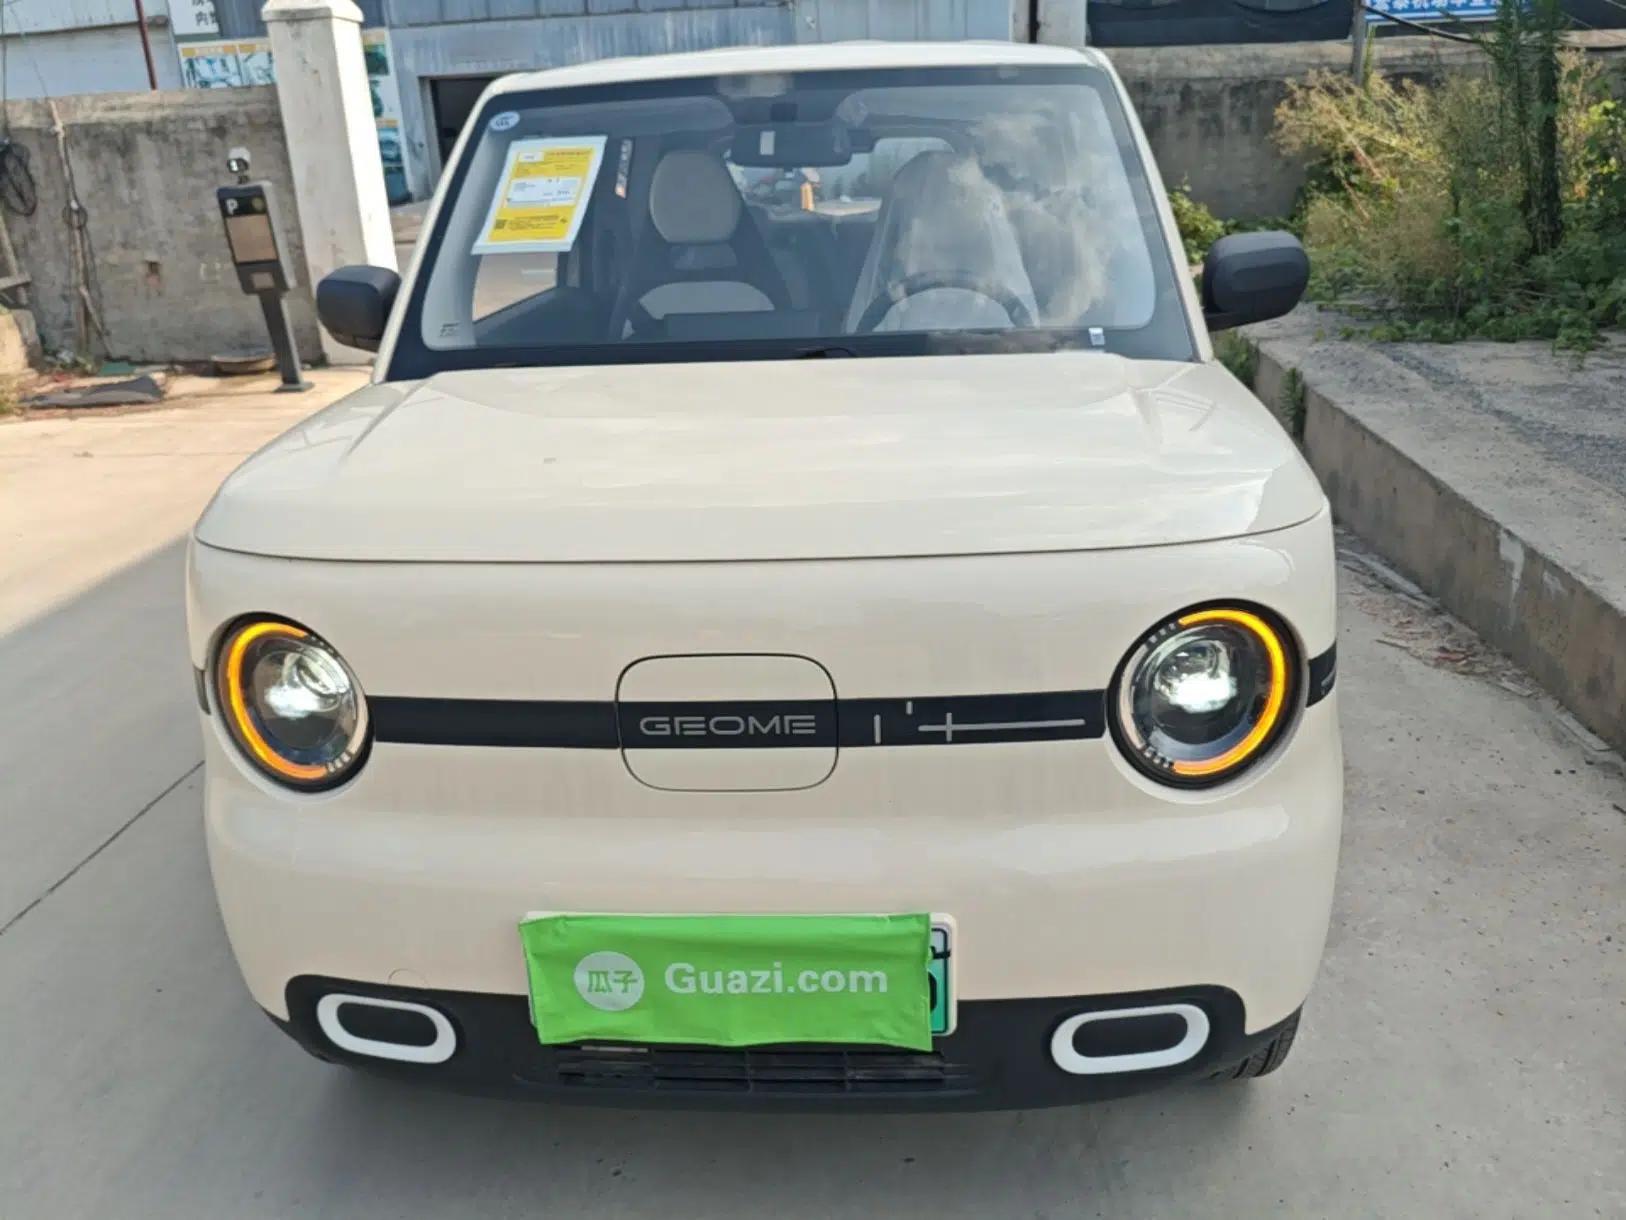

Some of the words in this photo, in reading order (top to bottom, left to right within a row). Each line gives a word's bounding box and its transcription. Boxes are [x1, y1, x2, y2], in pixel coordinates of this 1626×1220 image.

[639, 714, 817, 737] GEOME
[586, 970, 639, 994] 瓜子
[664, 961, 889, 995] Guazi.com
